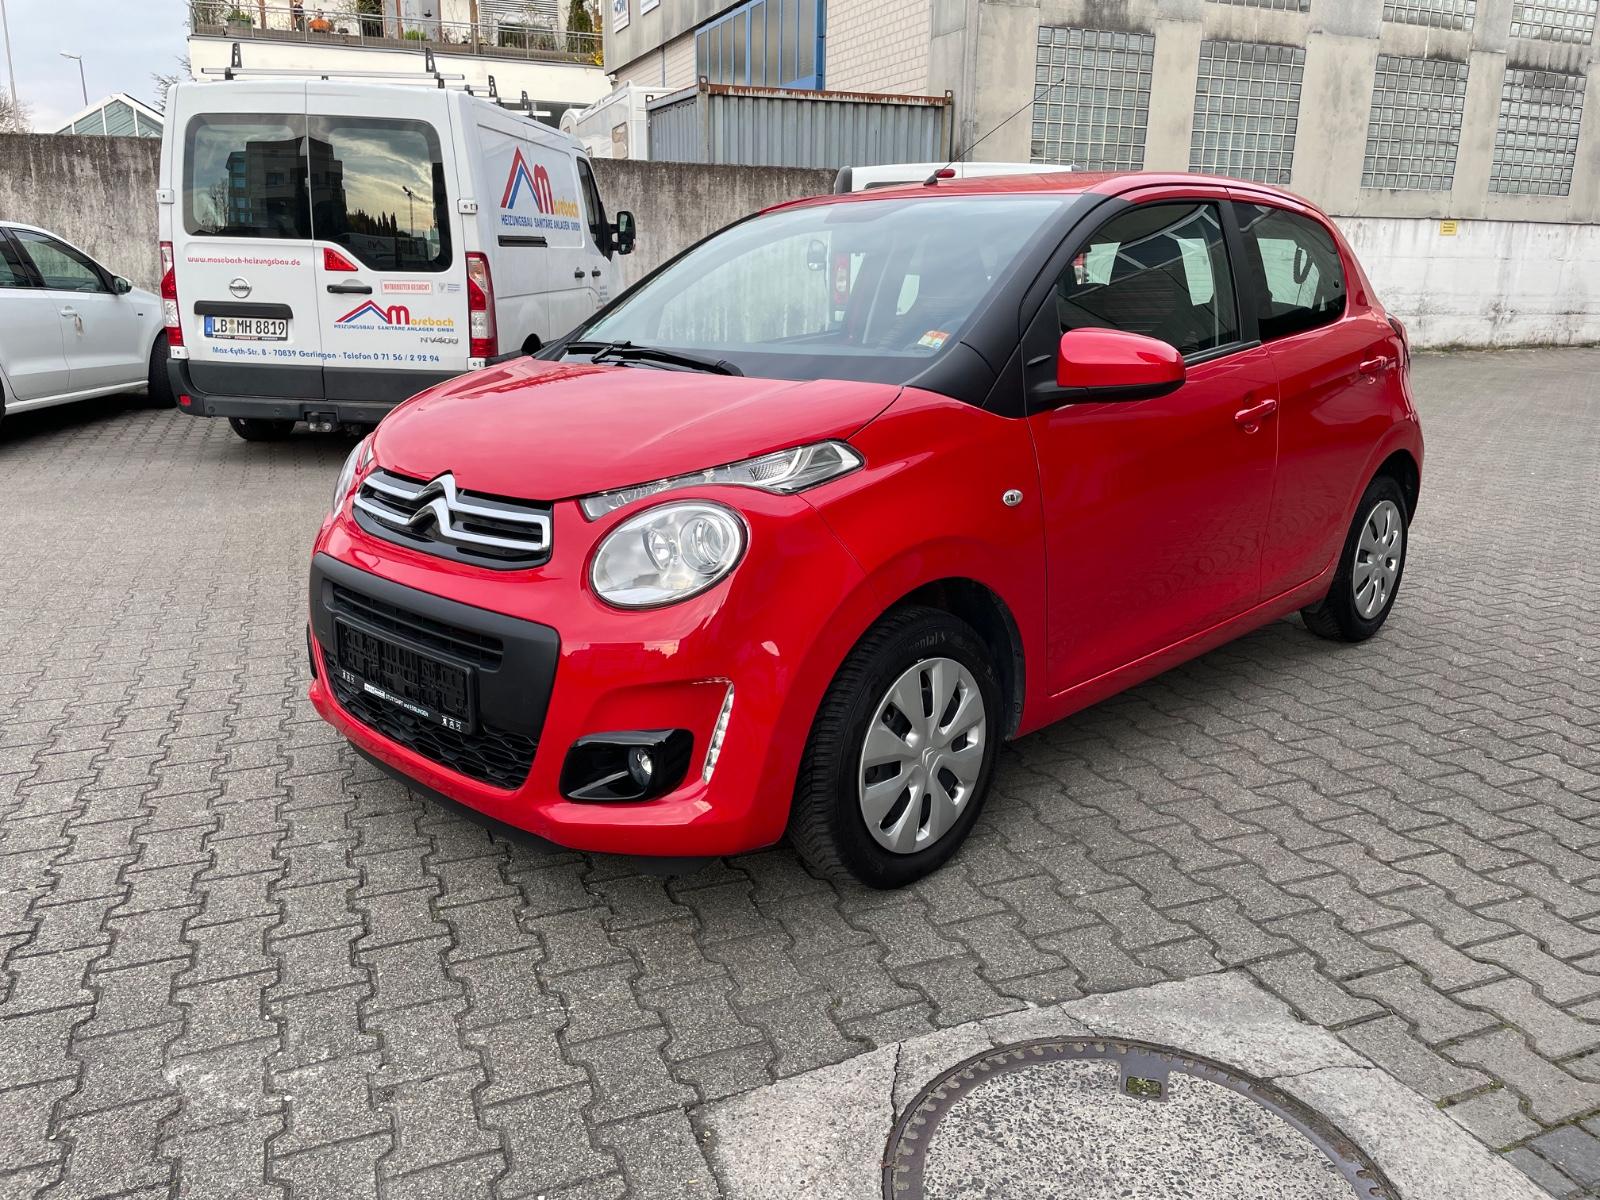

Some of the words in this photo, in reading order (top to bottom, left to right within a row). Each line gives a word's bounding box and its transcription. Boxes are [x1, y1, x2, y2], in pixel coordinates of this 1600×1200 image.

[187, 257, 301, 266] www.mosebach-heizungsbau.de
[213, 319, 228, 333] LB
[237, 320, 252, 334] MH
[255, 320, 285, 335] 8819
[212, 346, 260, 356] Max-Eyth-Str.
[273, 349, 297, 357] 70839
[299, 350, 336, 360] Gerlingen
[343, 352, 372, 360] Telefon
[393, 353, 402, 361] 56
[417, 354, 427, 362] 92
